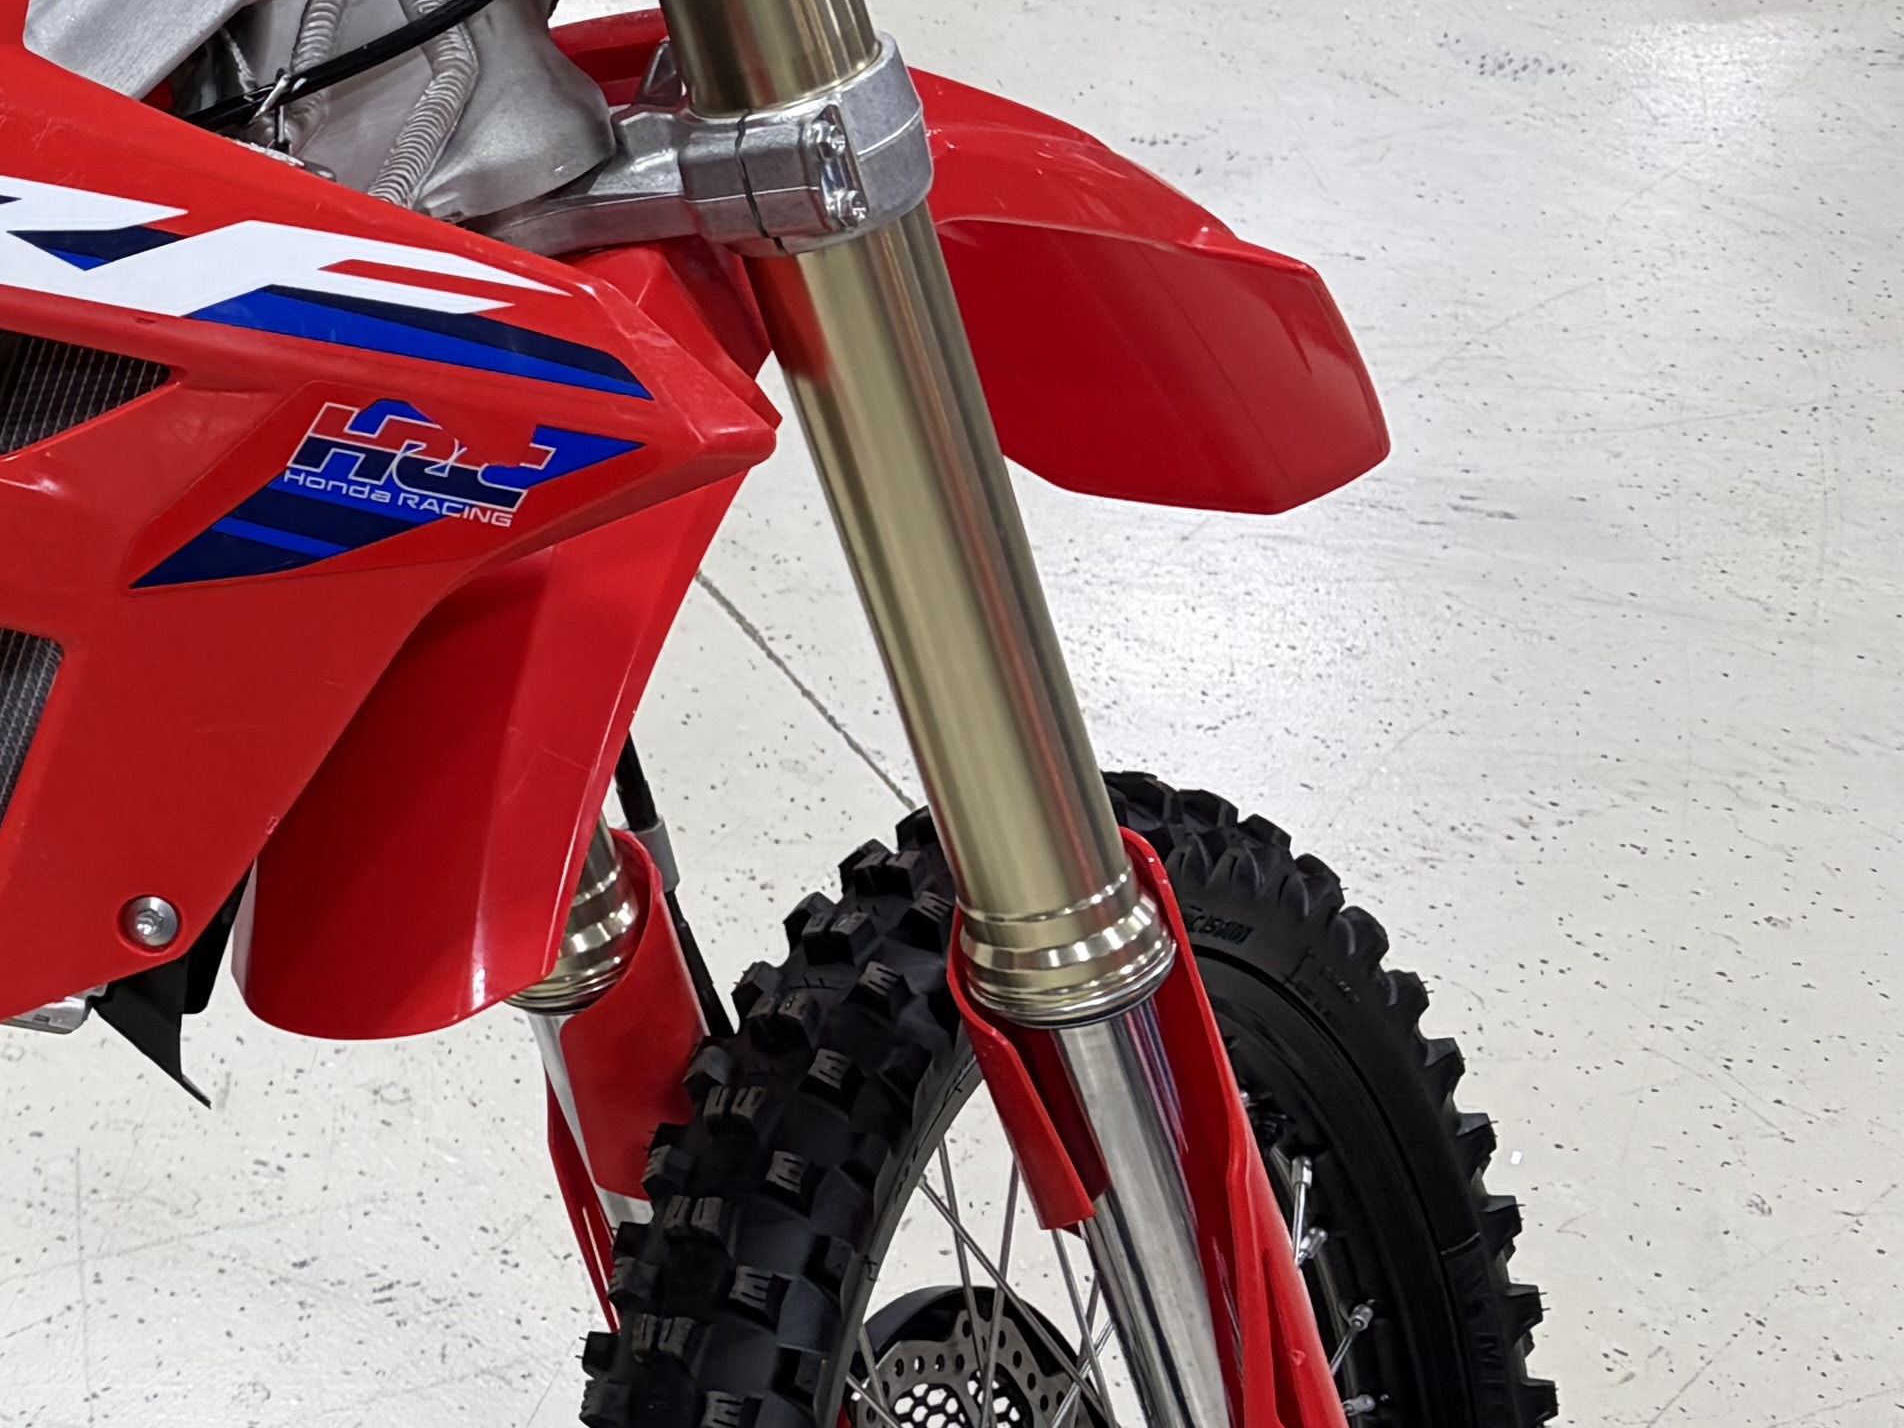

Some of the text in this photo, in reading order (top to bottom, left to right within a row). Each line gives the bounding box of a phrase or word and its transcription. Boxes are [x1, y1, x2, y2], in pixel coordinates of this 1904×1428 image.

[283, 469, 514, 528] Honda RACING
[287, 400, 557, 513] HRC
